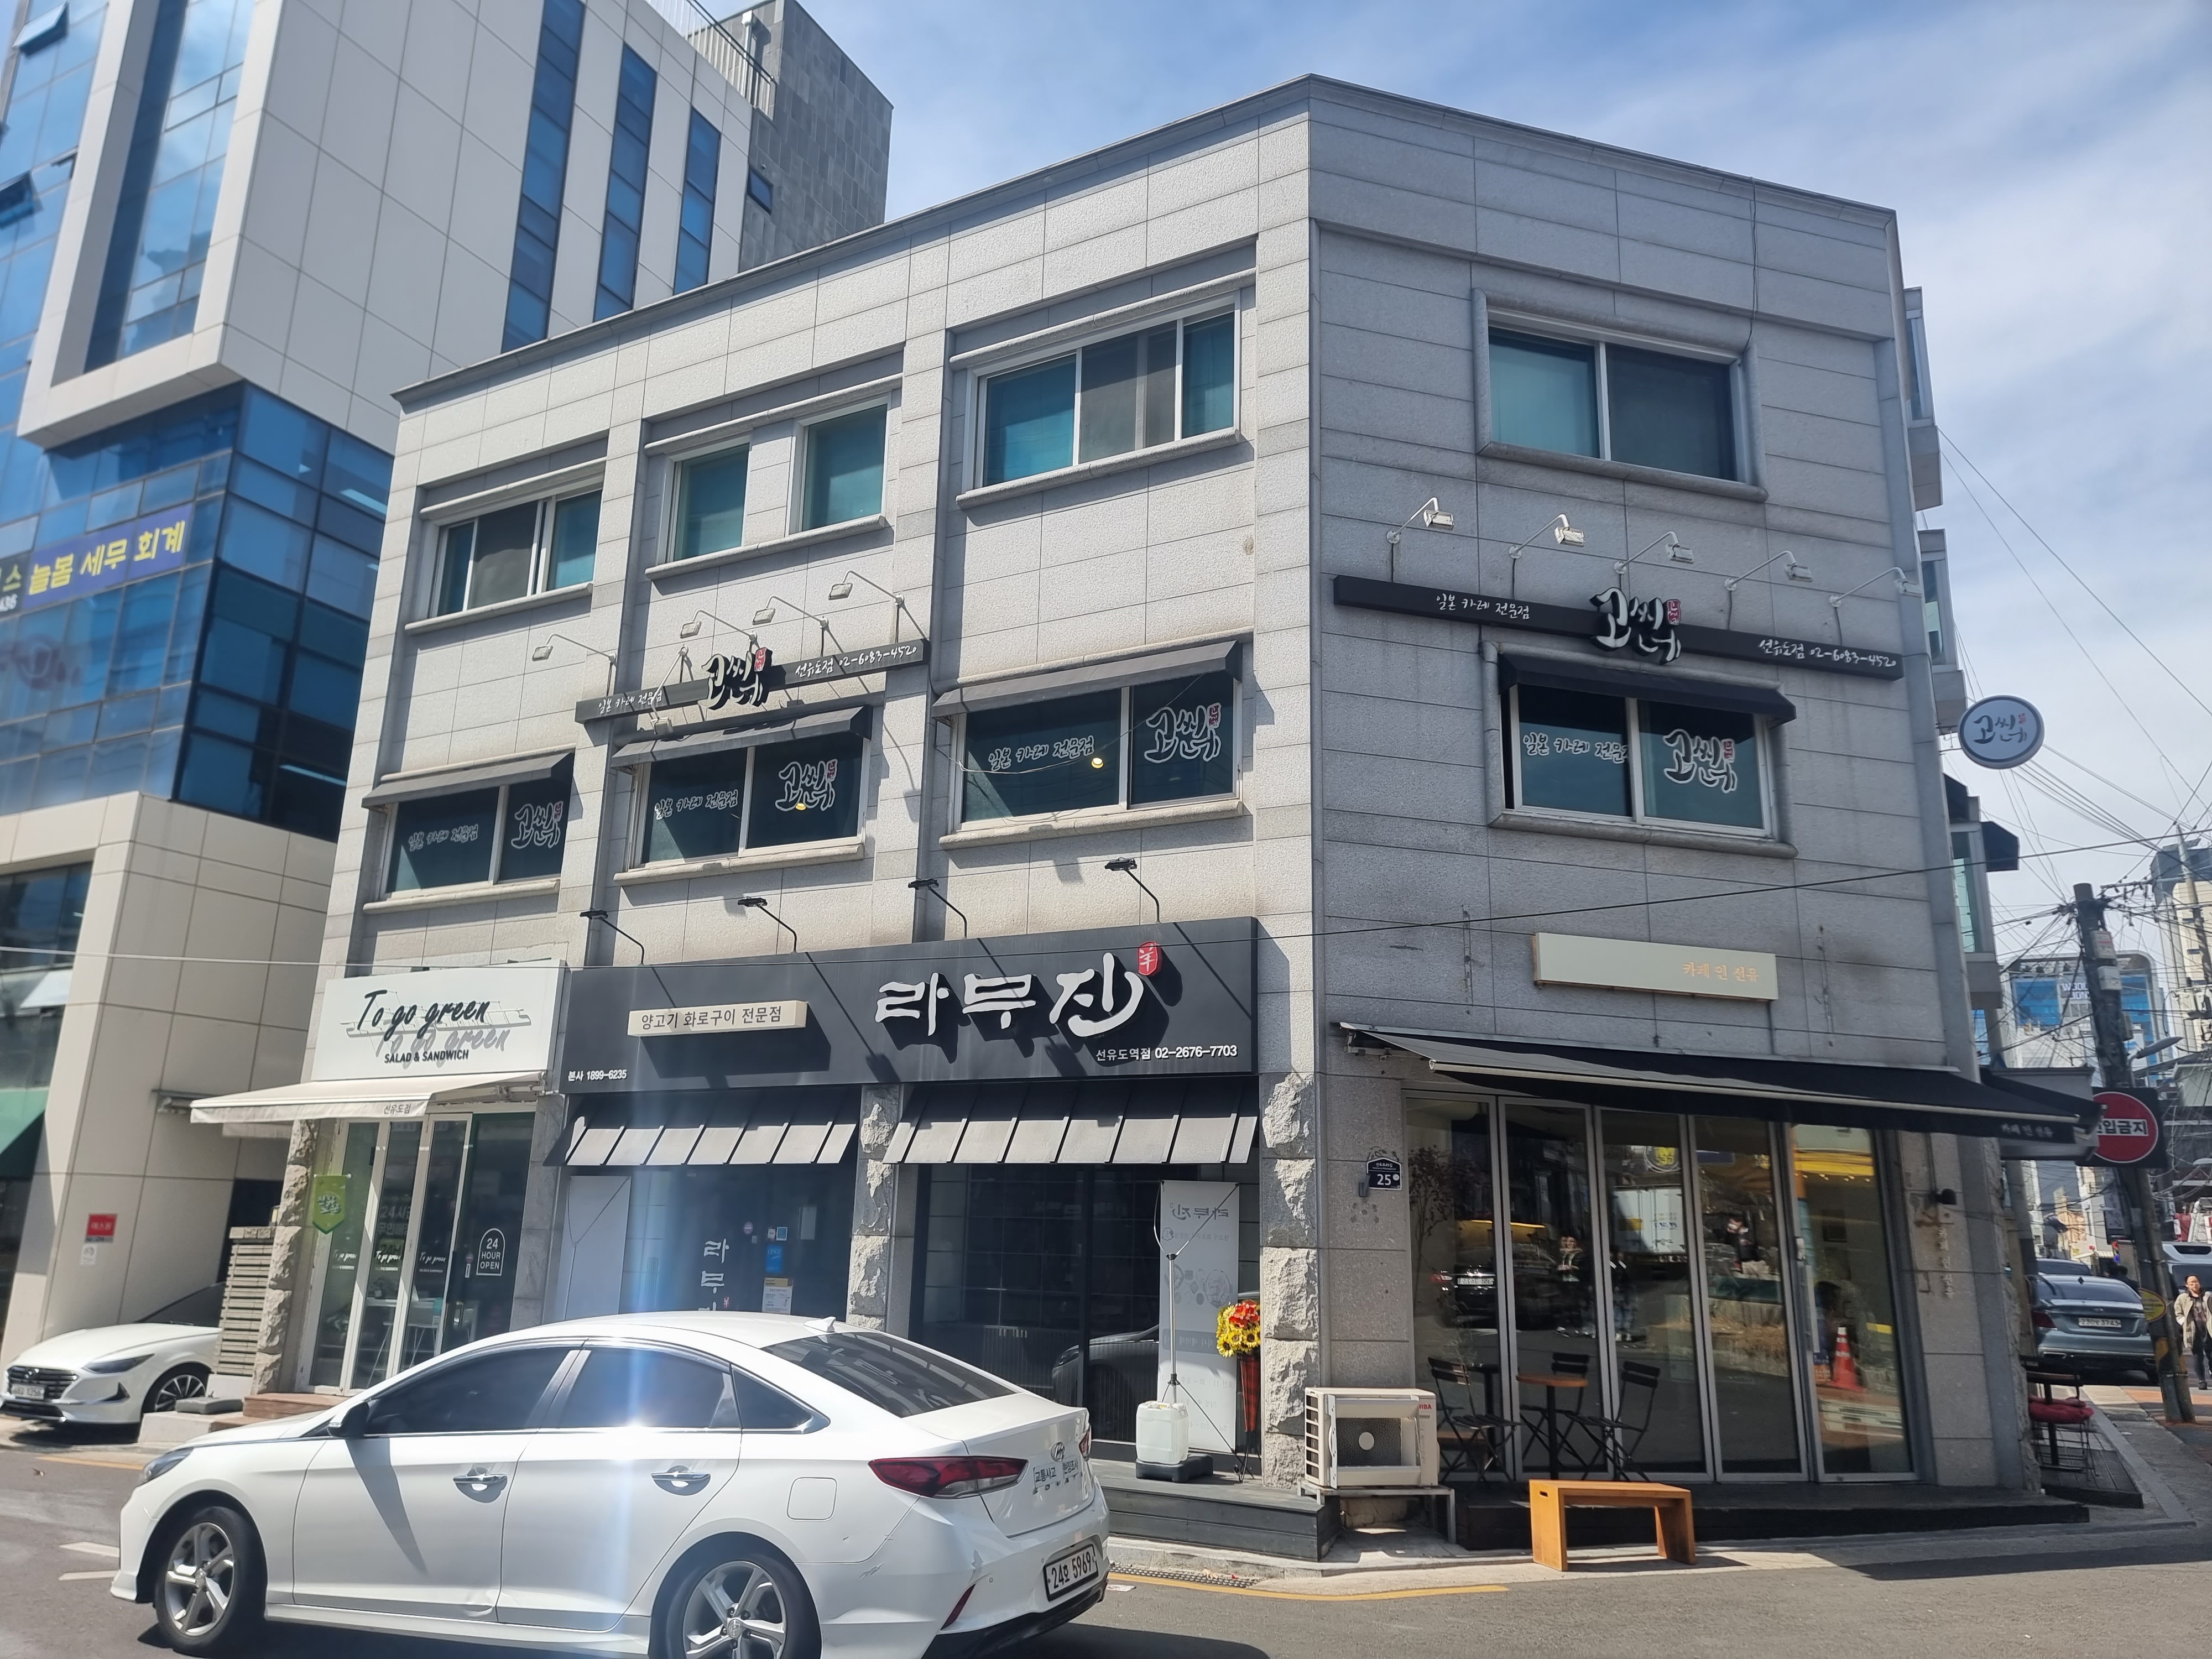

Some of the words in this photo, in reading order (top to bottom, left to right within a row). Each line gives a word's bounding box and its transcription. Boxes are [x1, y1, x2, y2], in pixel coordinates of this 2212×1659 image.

[29, 553, 74, 595] 늘봄
[80, 538, 127, 576] 세무
[134, 520, 185, 561] 회계
[1436, 593, 1456, 611] 일본
[1462, 598, 1490, 611] 카레
[1495, 602, 1530, 619] 전문점
[795, 658, 833, 677] 선유도점
[839, 645, 917, 667] 02-6083-4520
[1759, 639, 1805, 659] 선유도점
[1810, 647, 1897, 667] 02-6083-4520
[598, 698, 612, 714] 일본
[615, 696, 635, 708] 카레
[638, 690, 662, 706] 전문점
[988, 746, 1013, 771] 일본
[1015, 744, 1049, 763] 카레
[1052, 734, 1095, 759] 전문점
[1523, 732, 1550, 756] 일본
[1553, 737, 1590, 754] 카레
[654, 798, 674, 820] 일본
[676, 796, 703, 812] 카레
[705, 789, 738, 810] 전문점
[450, 824, 478, 843] 전문점
[1682, 961, 1710, 978] 카페
[1715, 964, 1728, 980] 인
[1734, 966, 1759, 983] 선유
[875, 952, 1144, 1037] 라무진
[357, 989, 388, 1030] To
[383, 1004, 418, 1041] go
[417, 1000, 491, 1039] green
[641, 1012, 679, 1030] 양고기
[683, 1008, 737, 1028] 화로구이
[742, 1005, 782, 1025] 전문점
[384, 1052, 412, 1064] SALAD
[413, 1052, 420, 1062] &
[422, 1049, 469, 1062] SANDWICH
[1095, 1047, 1152, 1062] 선유도역점
[1155, 1045, 1238, 1060] 02-2676-7703
[568, 1070, 584, 1082] 본사
[587, 1069, 627, 1081] 1899-6235
[2098, 1120, 2147, 1135] 입금지
[1377, 1173, 1391, 1186] 25
[486, 1237, 498, 1249] 24
[481, 1251, 501, 1260] HOUR
[698, 1238, 729, 1311] 라무
[1035, 1467, 1057, 1482] 교통사고
[1062, 1459, 1079, 1474] 현장조사
[1052, 1564, 1070, 1589] 24호
[1072, 1551, 1091, 1579] 5969
